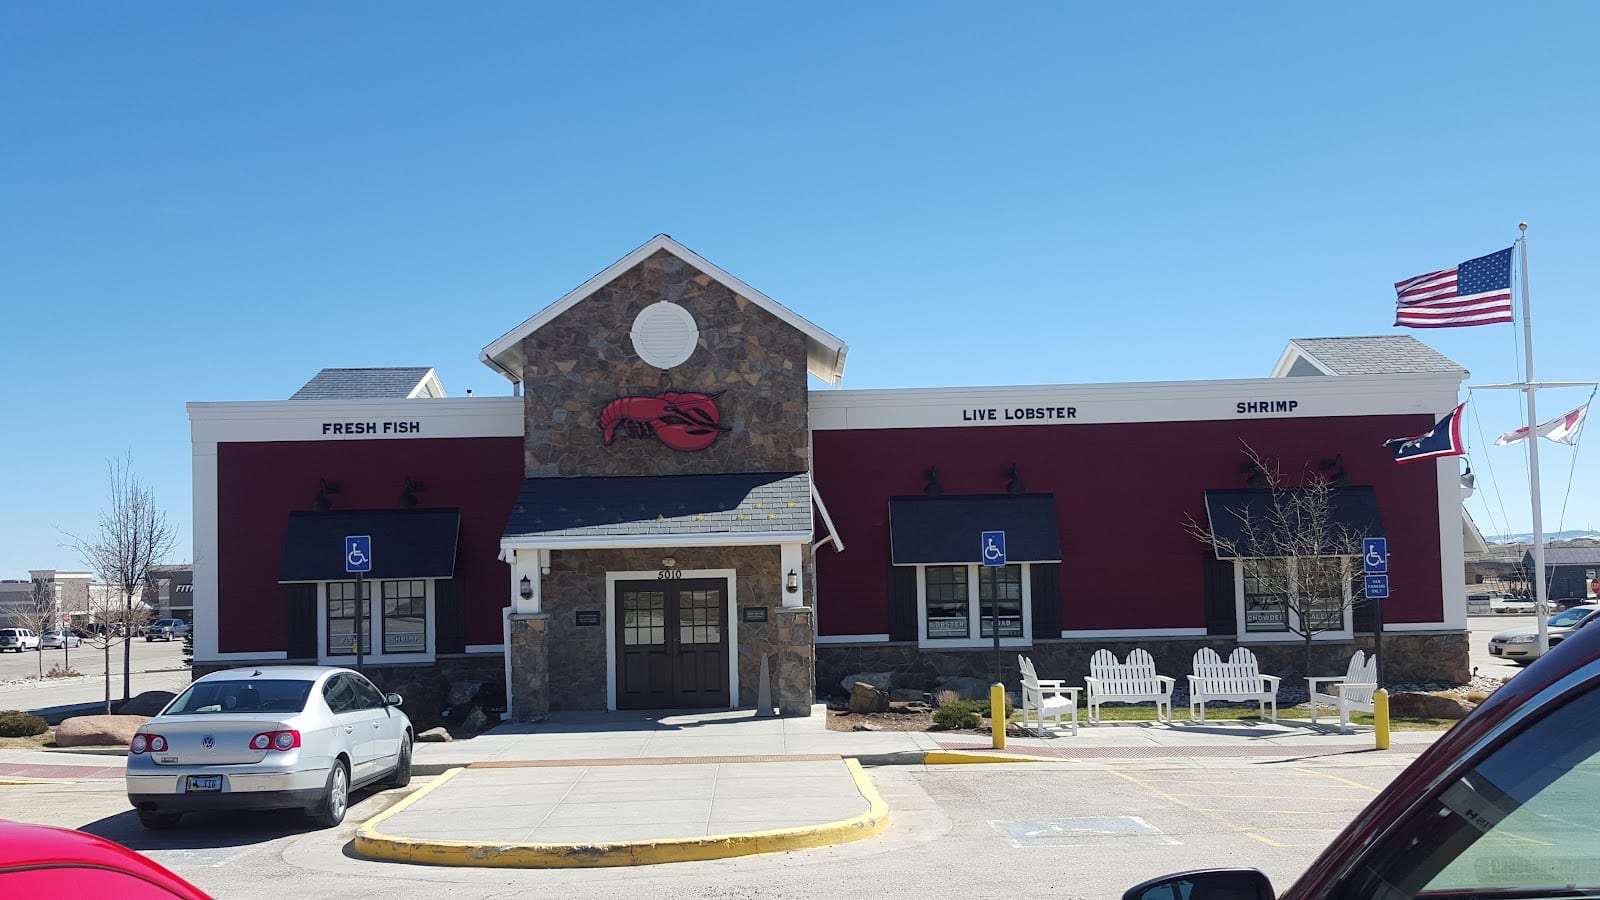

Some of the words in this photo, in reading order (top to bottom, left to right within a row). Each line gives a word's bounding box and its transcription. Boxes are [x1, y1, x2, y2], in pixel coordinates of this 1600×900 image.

[1236, 400, 1298, 413] SHRIMP
[963, 409, 997, 421] LIVE
[1005, 408, 1077, 420] LOBSTER
[322, 423, 376, 434] FRESH
[383, 421, 420, 433] FISH
[658, 570, 681, 579] 5010
